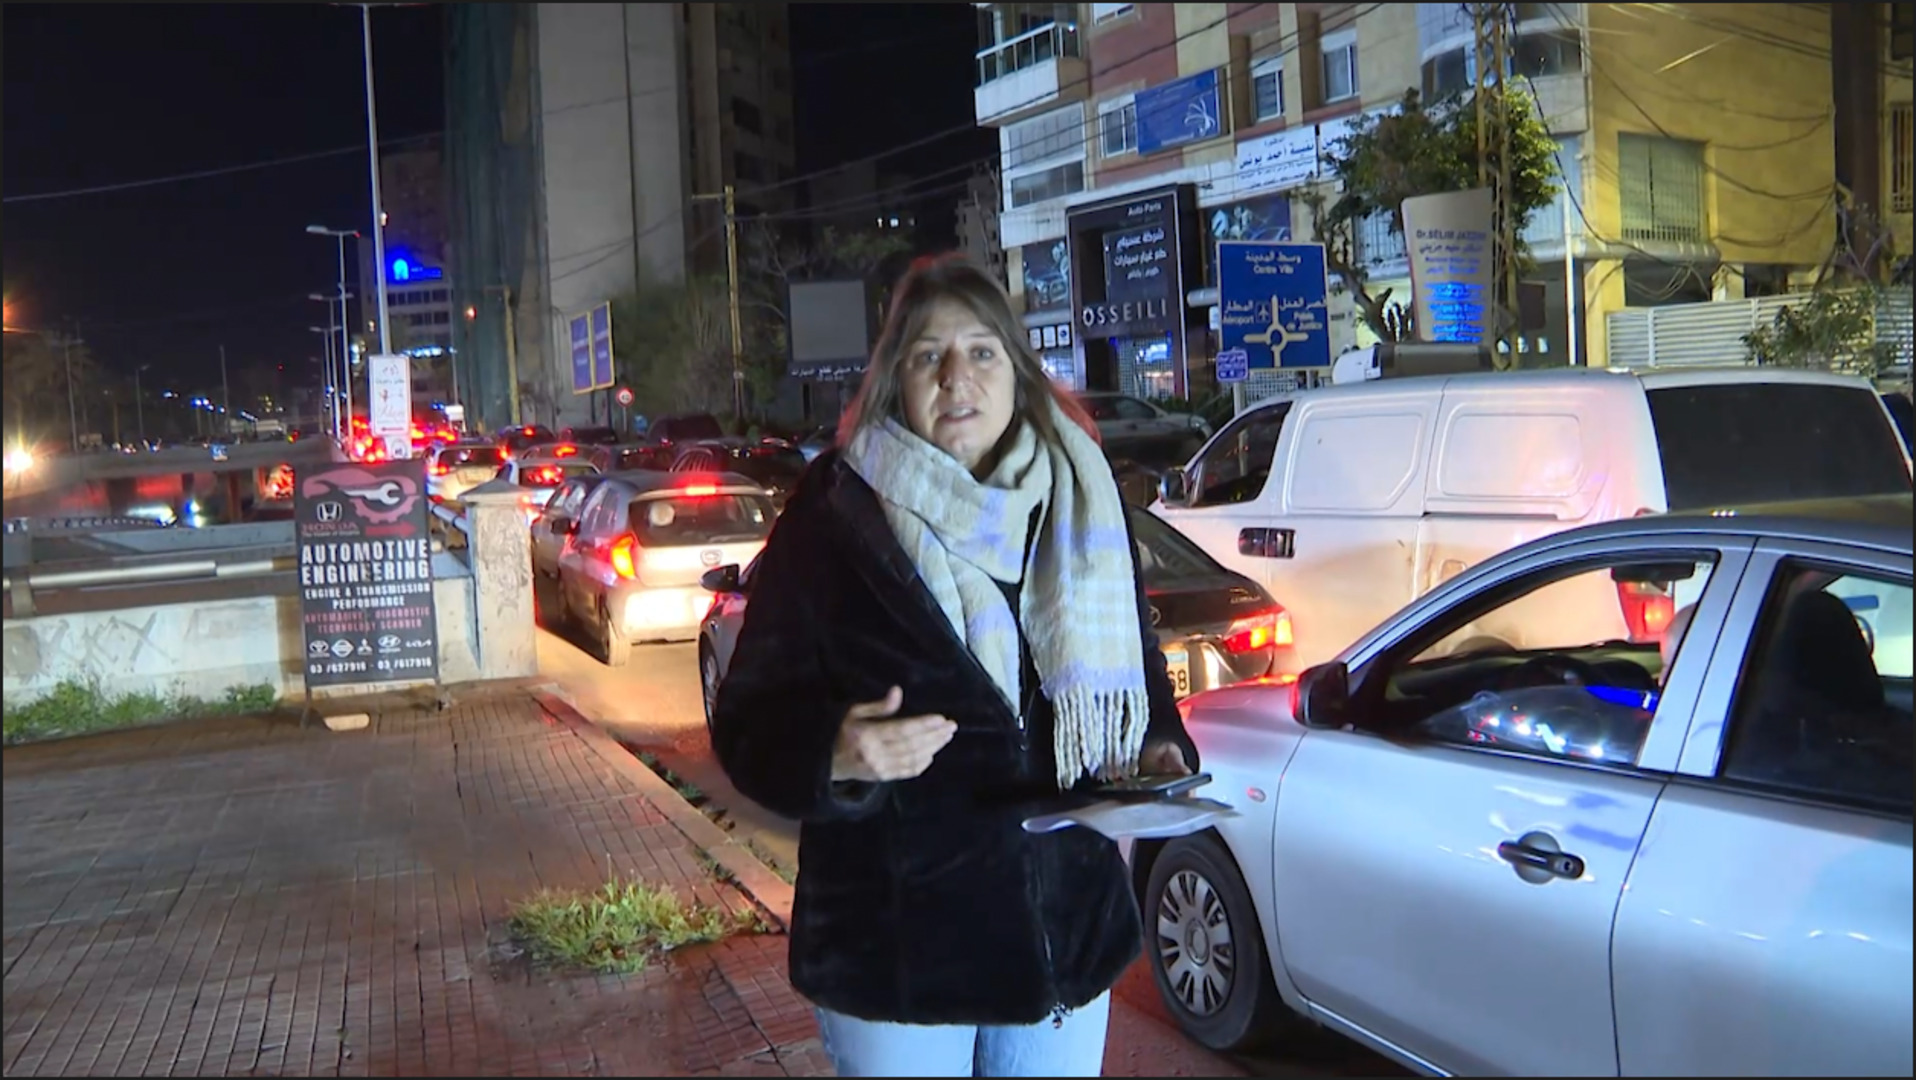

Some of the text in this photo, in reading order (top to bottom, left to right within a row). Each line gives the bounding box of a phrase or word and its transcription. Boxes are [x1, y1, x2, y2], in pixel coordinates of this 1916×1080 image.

[1245, 250, 1302, 264] وسط المدينة
[1253, 264, 1294, 274] Centre Ville
[1083, 298, 1167, 327] OSSEILI
[1224, 300, 1254, 313] المطار
[302, 521, 359, 531] HONDA
[302, 539, 428, 564] AUTOMOTIVE
[302, 561, 429, 585] ENGINEERING
[305, 583, 430, 599] ENGINE & TRANSMISSION
[332, 596, 405, 610] PERFORMANCE
[318, 618, 422, 634] TECHNOLOGY SCANNER
[310, 664, 323, 674] 03
[378, 659, 391, 670] 03
